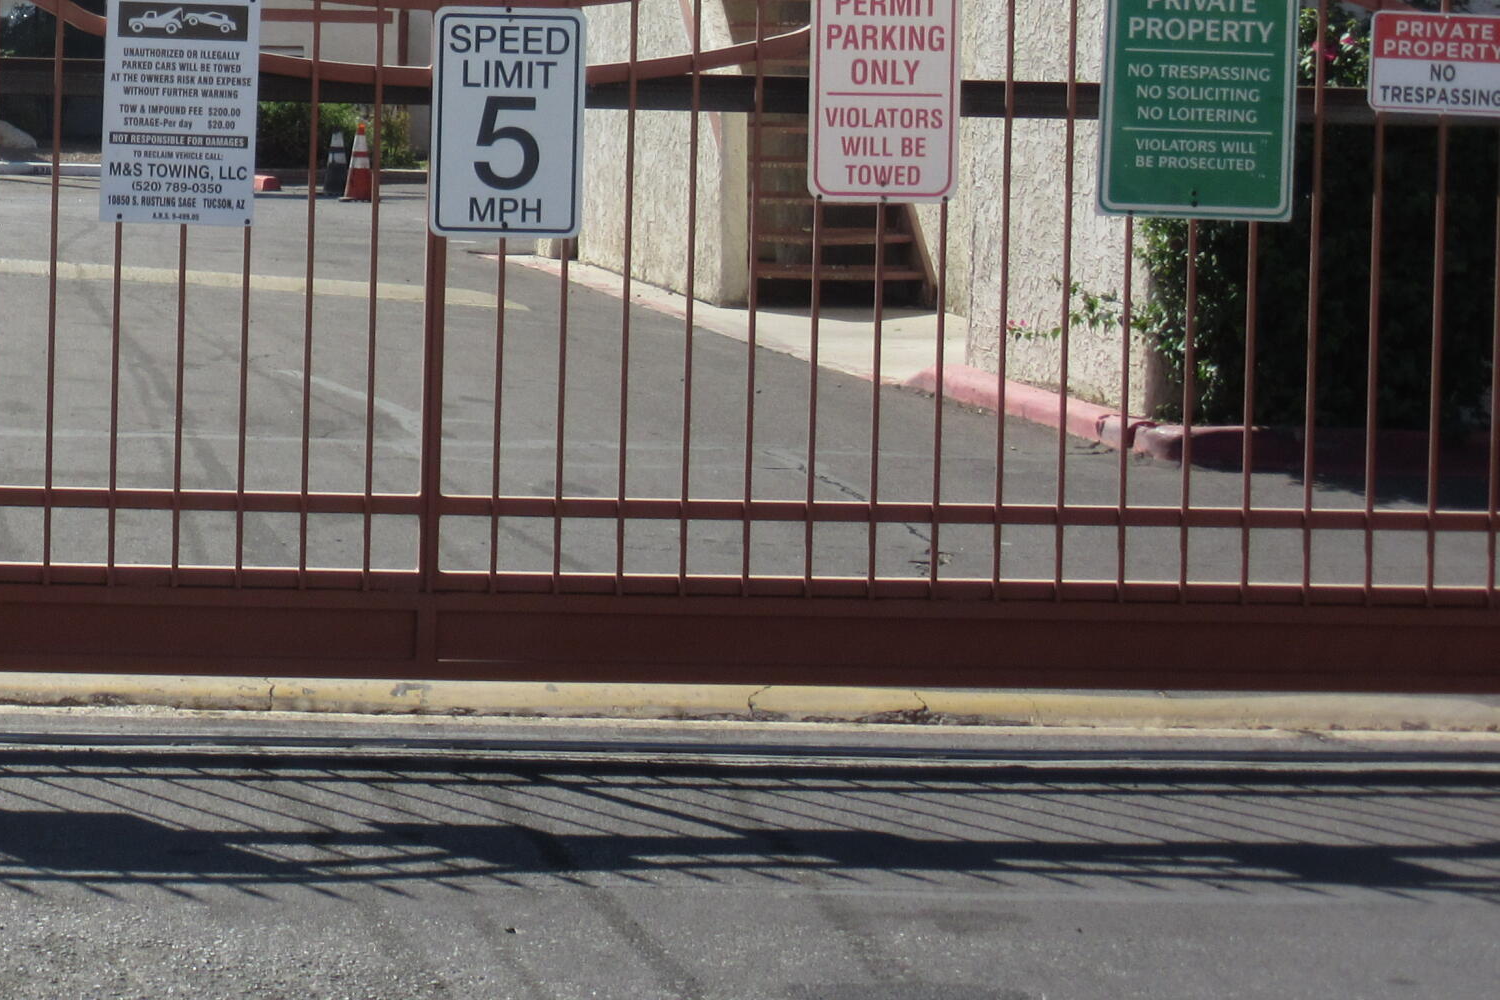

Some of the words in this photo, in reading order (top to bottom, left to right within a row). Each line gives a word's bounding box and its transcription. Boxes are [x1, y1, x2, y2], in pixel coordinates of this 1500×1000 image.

[826, 24, 946, 52] PARKING
[1128, 16, 1275, 43] PROPERTY
[1395, 20, 1494, 40] PRIVATE
[450, 24, 570, 55] SPEED
[123, 48, 184, 59] UNAUTHORIZED
[186, 49, 198, 59] OR
[200, 50, 240, 61] ILLEGALLY
[1383, 39, 1500, 60] PROPERTY
[122, 60, 153, 70] PARKED
[155, 61, 176, 71] CARS
[179, 62, 198, 72] WILL
[200, 63, 211, 72] BE
[213, 63, 241, 73] TOWED
[462, 59, 558, 89] LIMIT
[851, 58, 921, 86] ONLY
[1127, 63, 1154, 78] NO
[1158, 64, 1270, 82] TRESPASSING
[1430, 63, 1456, 82] NO
[111, 73, 120, 82] AT
[123, 73, 138, 83] THE
[140, 74, 174, 84] OWNERS
[177, 75, 195, 84] RISK
[197, 76, 214, 85] AND
[216, 77, 252, 87] EXPENSE
[123, 86, 160, 97] WITHOUT
[162, 87, 199, 97] FURTHER
[201, 88, 238, 99] WARNING
[1136, 85, 1162, 99] NO
[1166, 86, 1260, 102] SOLICITING
[1380, 85, 1500, 107] TRESPASSING
[119, 104, 137, 113] TOW
[140, 105, 146, 114] &
[148, 105, 186, 115] IMPOUND
[188, 106, 203, 116] FEE
[208, 107, 241, 117] $200.00
[825, 107, 943, 129] VIOLATORS
[1137, 106, 1163, 120] NO
[1168, 107, 1257, 124] LOITERING
[178, 118, 193, 130] day
[207, 119, 235, 130] $20.00
[112, 133, 128, 143] NOT
[130, 134, 185, 145] RESPONSIBLE
[187, 136, 204, 146] FOR
[205, 136, 244, 147] DAMAGES
[473, 95, 540, 191] 5
[841, 136, 893, 157] WILL
[901, 137, 926, 157] BE
[1135, 138, 1217, 153] VIOLATORS
[1221, 141, 1256, 154] WILL
[133, 150, 142, 158] TO
[144, 150, 174, 159] RECLAIM
[175, 151, 204, 160] VEHICLE
[1135, 156, 1154, 168] BE
[1158, 156, 1256, 171] PROSECUTED
[109, 162, 142, 177] M&S
[148, 163, 214, 181] TOWING,
[219, 165, 248, 181] LLC
[845, 164, 921, 186] TOWED
[132, 180, 161, 192] (520)
[165, 182, 222, 194] 789-0350
[132, 195, 139, 206] S.
[141, 196, 176, 208] RUSTLING
[178, 197, 197, 208] SAGE
[203, 198, 234, 211] TUCSON,
[236, 199, 245, 210] AZ
[469, 197, 542, 223] MPH
